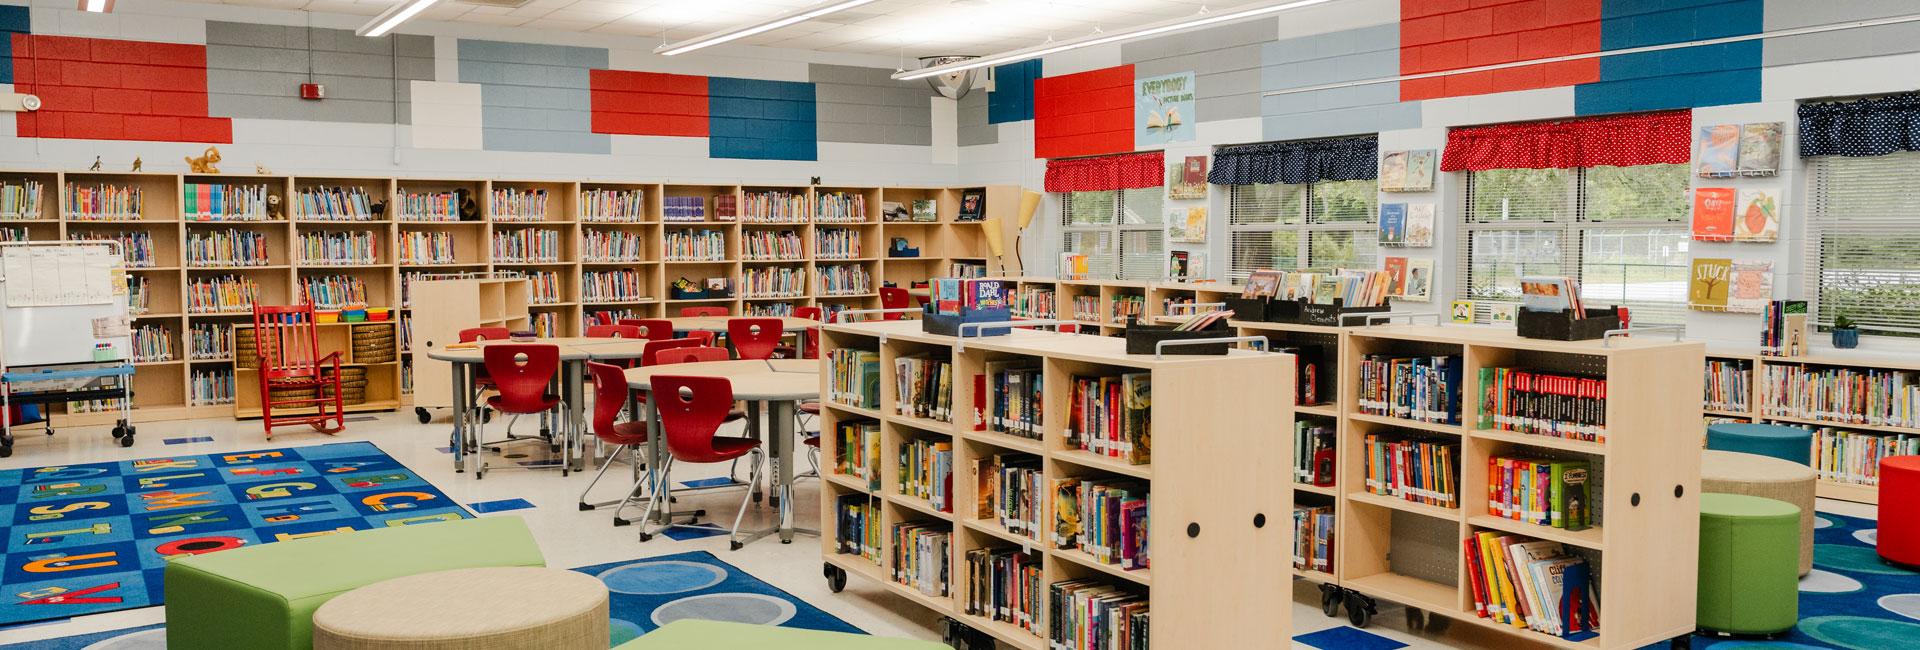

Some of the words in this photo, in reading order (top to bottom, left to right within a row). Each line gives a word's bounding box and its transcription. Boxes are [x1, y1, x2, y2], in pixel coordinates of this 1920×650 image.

[1142, 76, 1187, 96] EVERYBODY
[1163, 95, 1179, 103] PICTURE
[1180, 93, 1193, 102] BOOKS
[1697, 264, 1730, 281] STUCK
[979, 282, 1000, 290] ROALD
[979, 288, 999, 298] DAHL
[1304, 305, 1324, 314] Andrew
[1310, 314, 1336, 323] Clements
[223, 451, 283, 462] E
[235, 467, 302, 476] F
[341, 473, 409, 485] B
[31, 484, 107, 499] R
[245, 482, 317, 498] G
[143, 491, 221, 511] M
[361, 491, 437, 506] C
[29, 501, 112, 515] S
[148, 510, 230, 529] N
[26, 522, 112, 539] T
[155, 536, 247, 555] O
[22, 551, 119, 573] U
[15, 582, 124, 605] V
